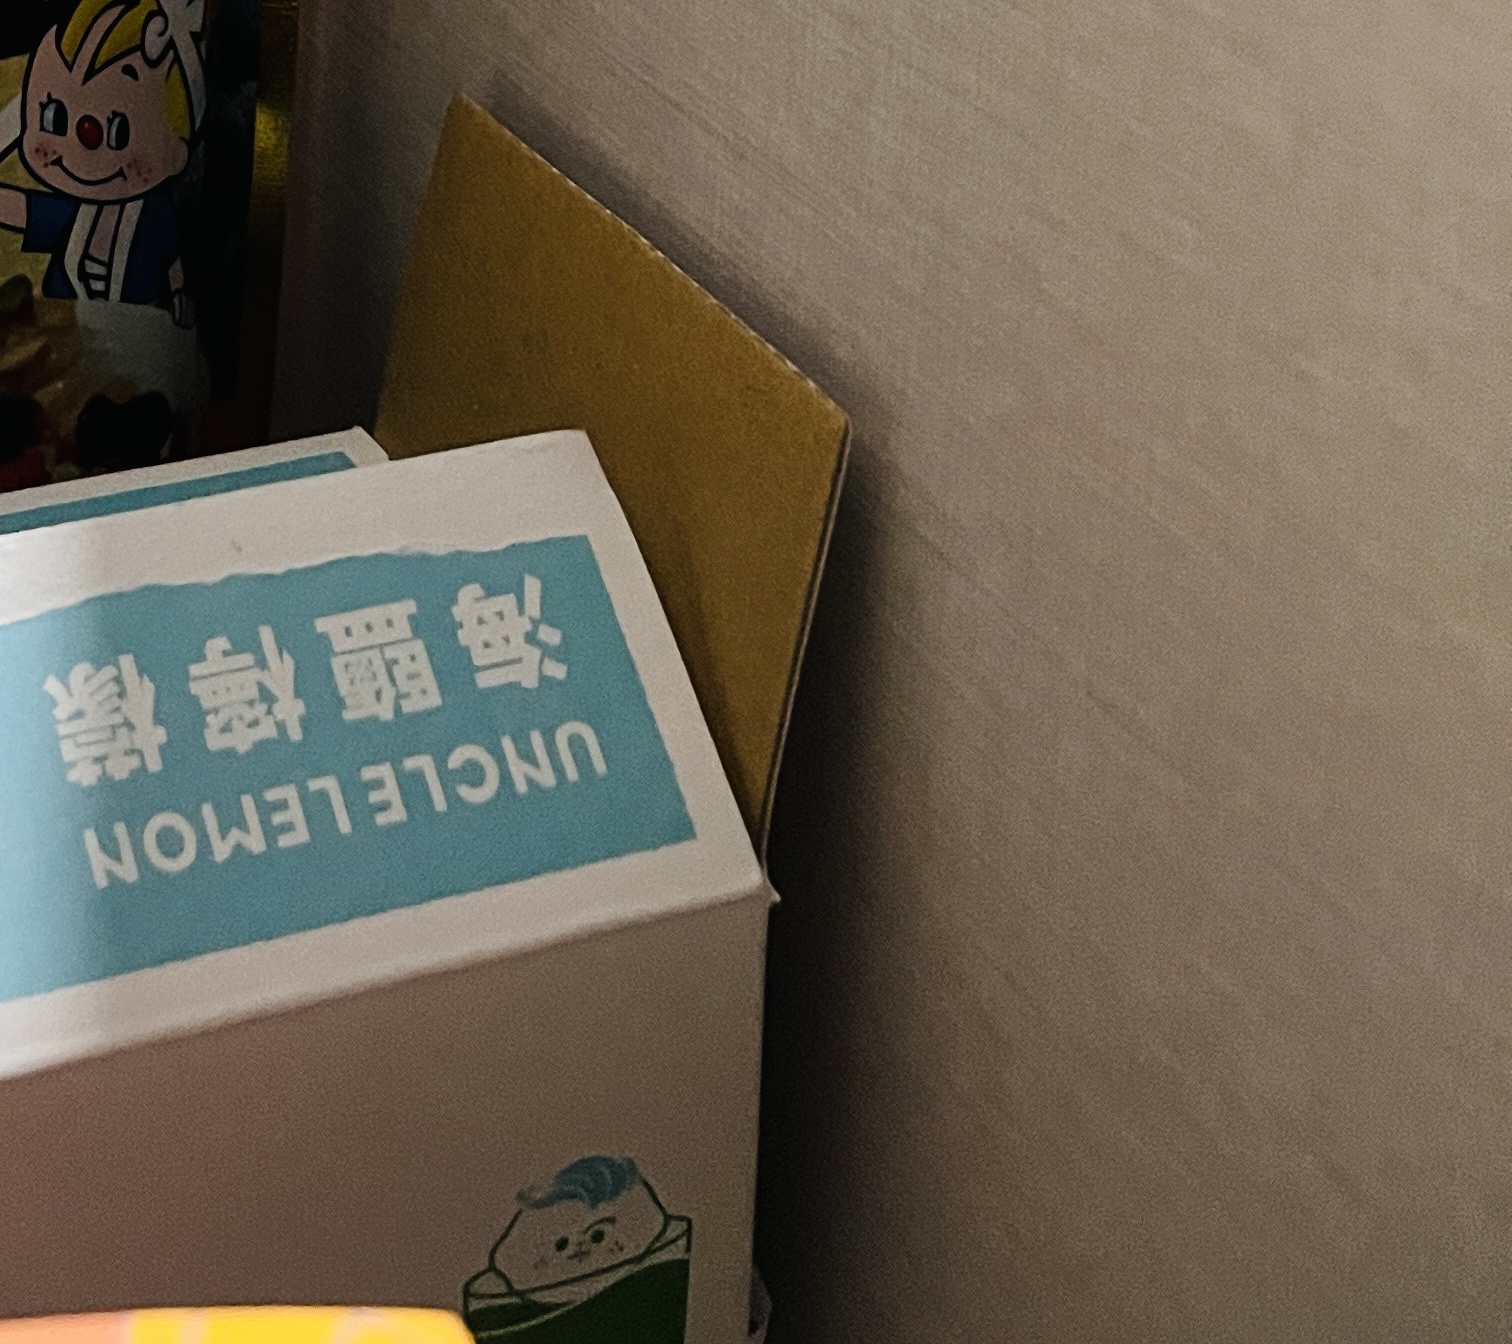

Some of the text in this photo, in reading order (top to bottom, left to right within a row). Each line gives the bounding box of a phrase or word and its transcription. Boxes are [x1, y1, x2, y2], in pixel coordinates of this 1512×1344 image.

[42, 574, 568, 787] 海鹽檸檬
[82, 721, 608, 888] UNCLE LEMON
